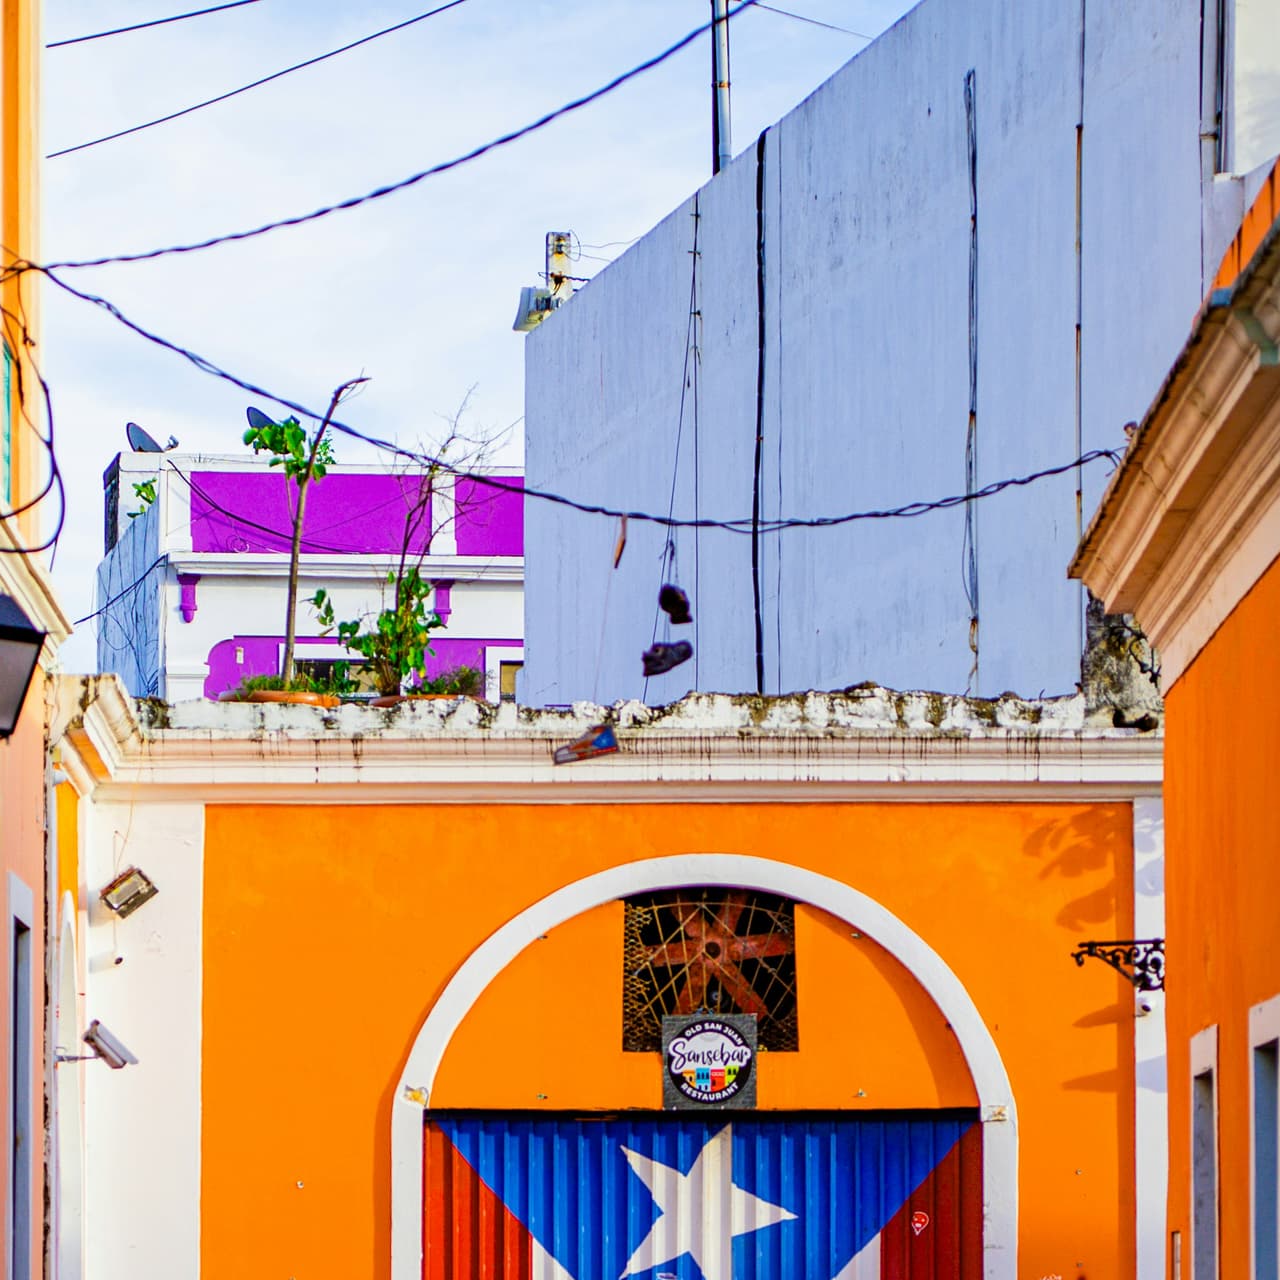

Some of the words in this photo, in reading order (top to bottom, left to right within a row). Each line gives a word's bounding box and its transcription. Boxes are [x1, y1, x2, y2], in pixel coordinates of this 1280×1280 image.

[685, 1024, 702, 1037] OLD
[704, 1022, 722, 1030] SAN
[723, 1026, 743, 1045] JUAN
[672, 1041, 748, 1070] Sansebar
[681, 1082, 739, 1101] RESTAURANT
